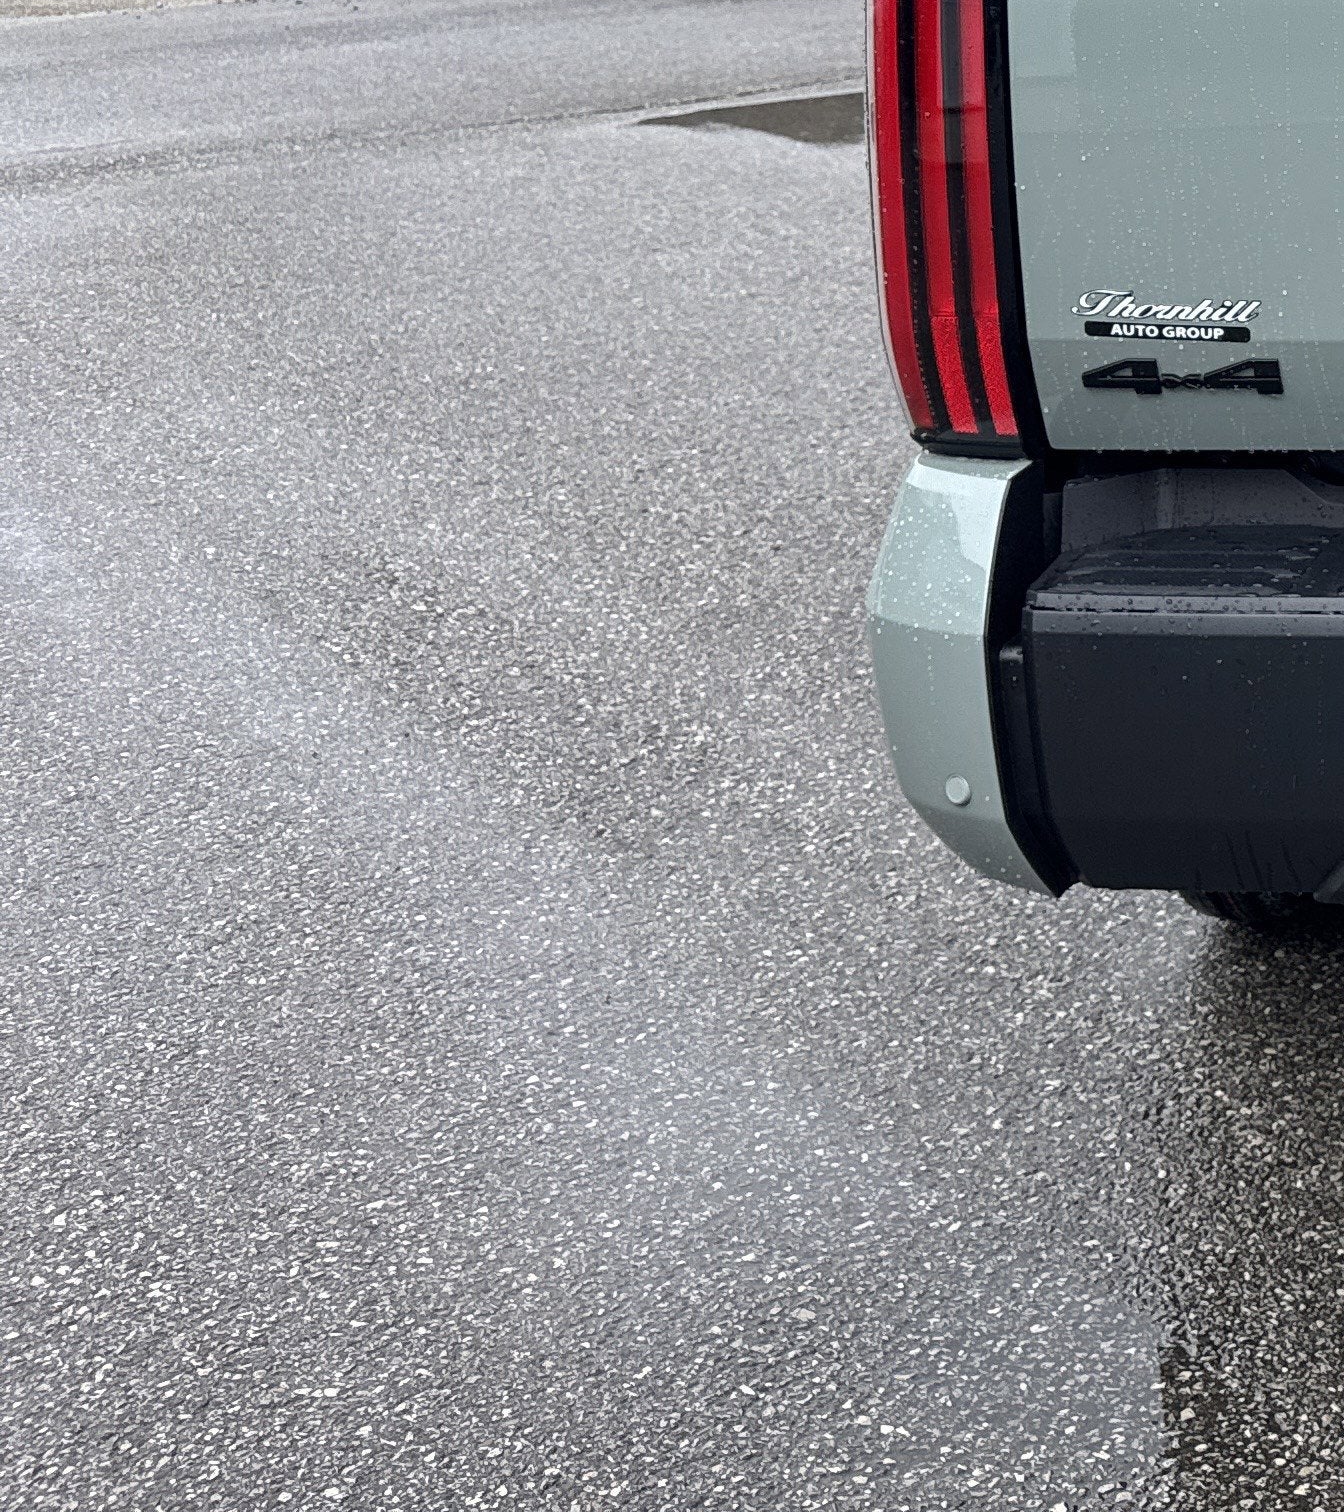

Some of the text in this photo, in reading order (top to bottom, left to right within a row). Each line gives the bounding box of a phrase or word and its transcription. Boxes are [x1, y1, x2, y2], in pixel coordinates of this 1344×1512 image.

[1071, 289, 1261, 323] Thornhill
[1110, 323, 1225, 341] AUTO GROUP
